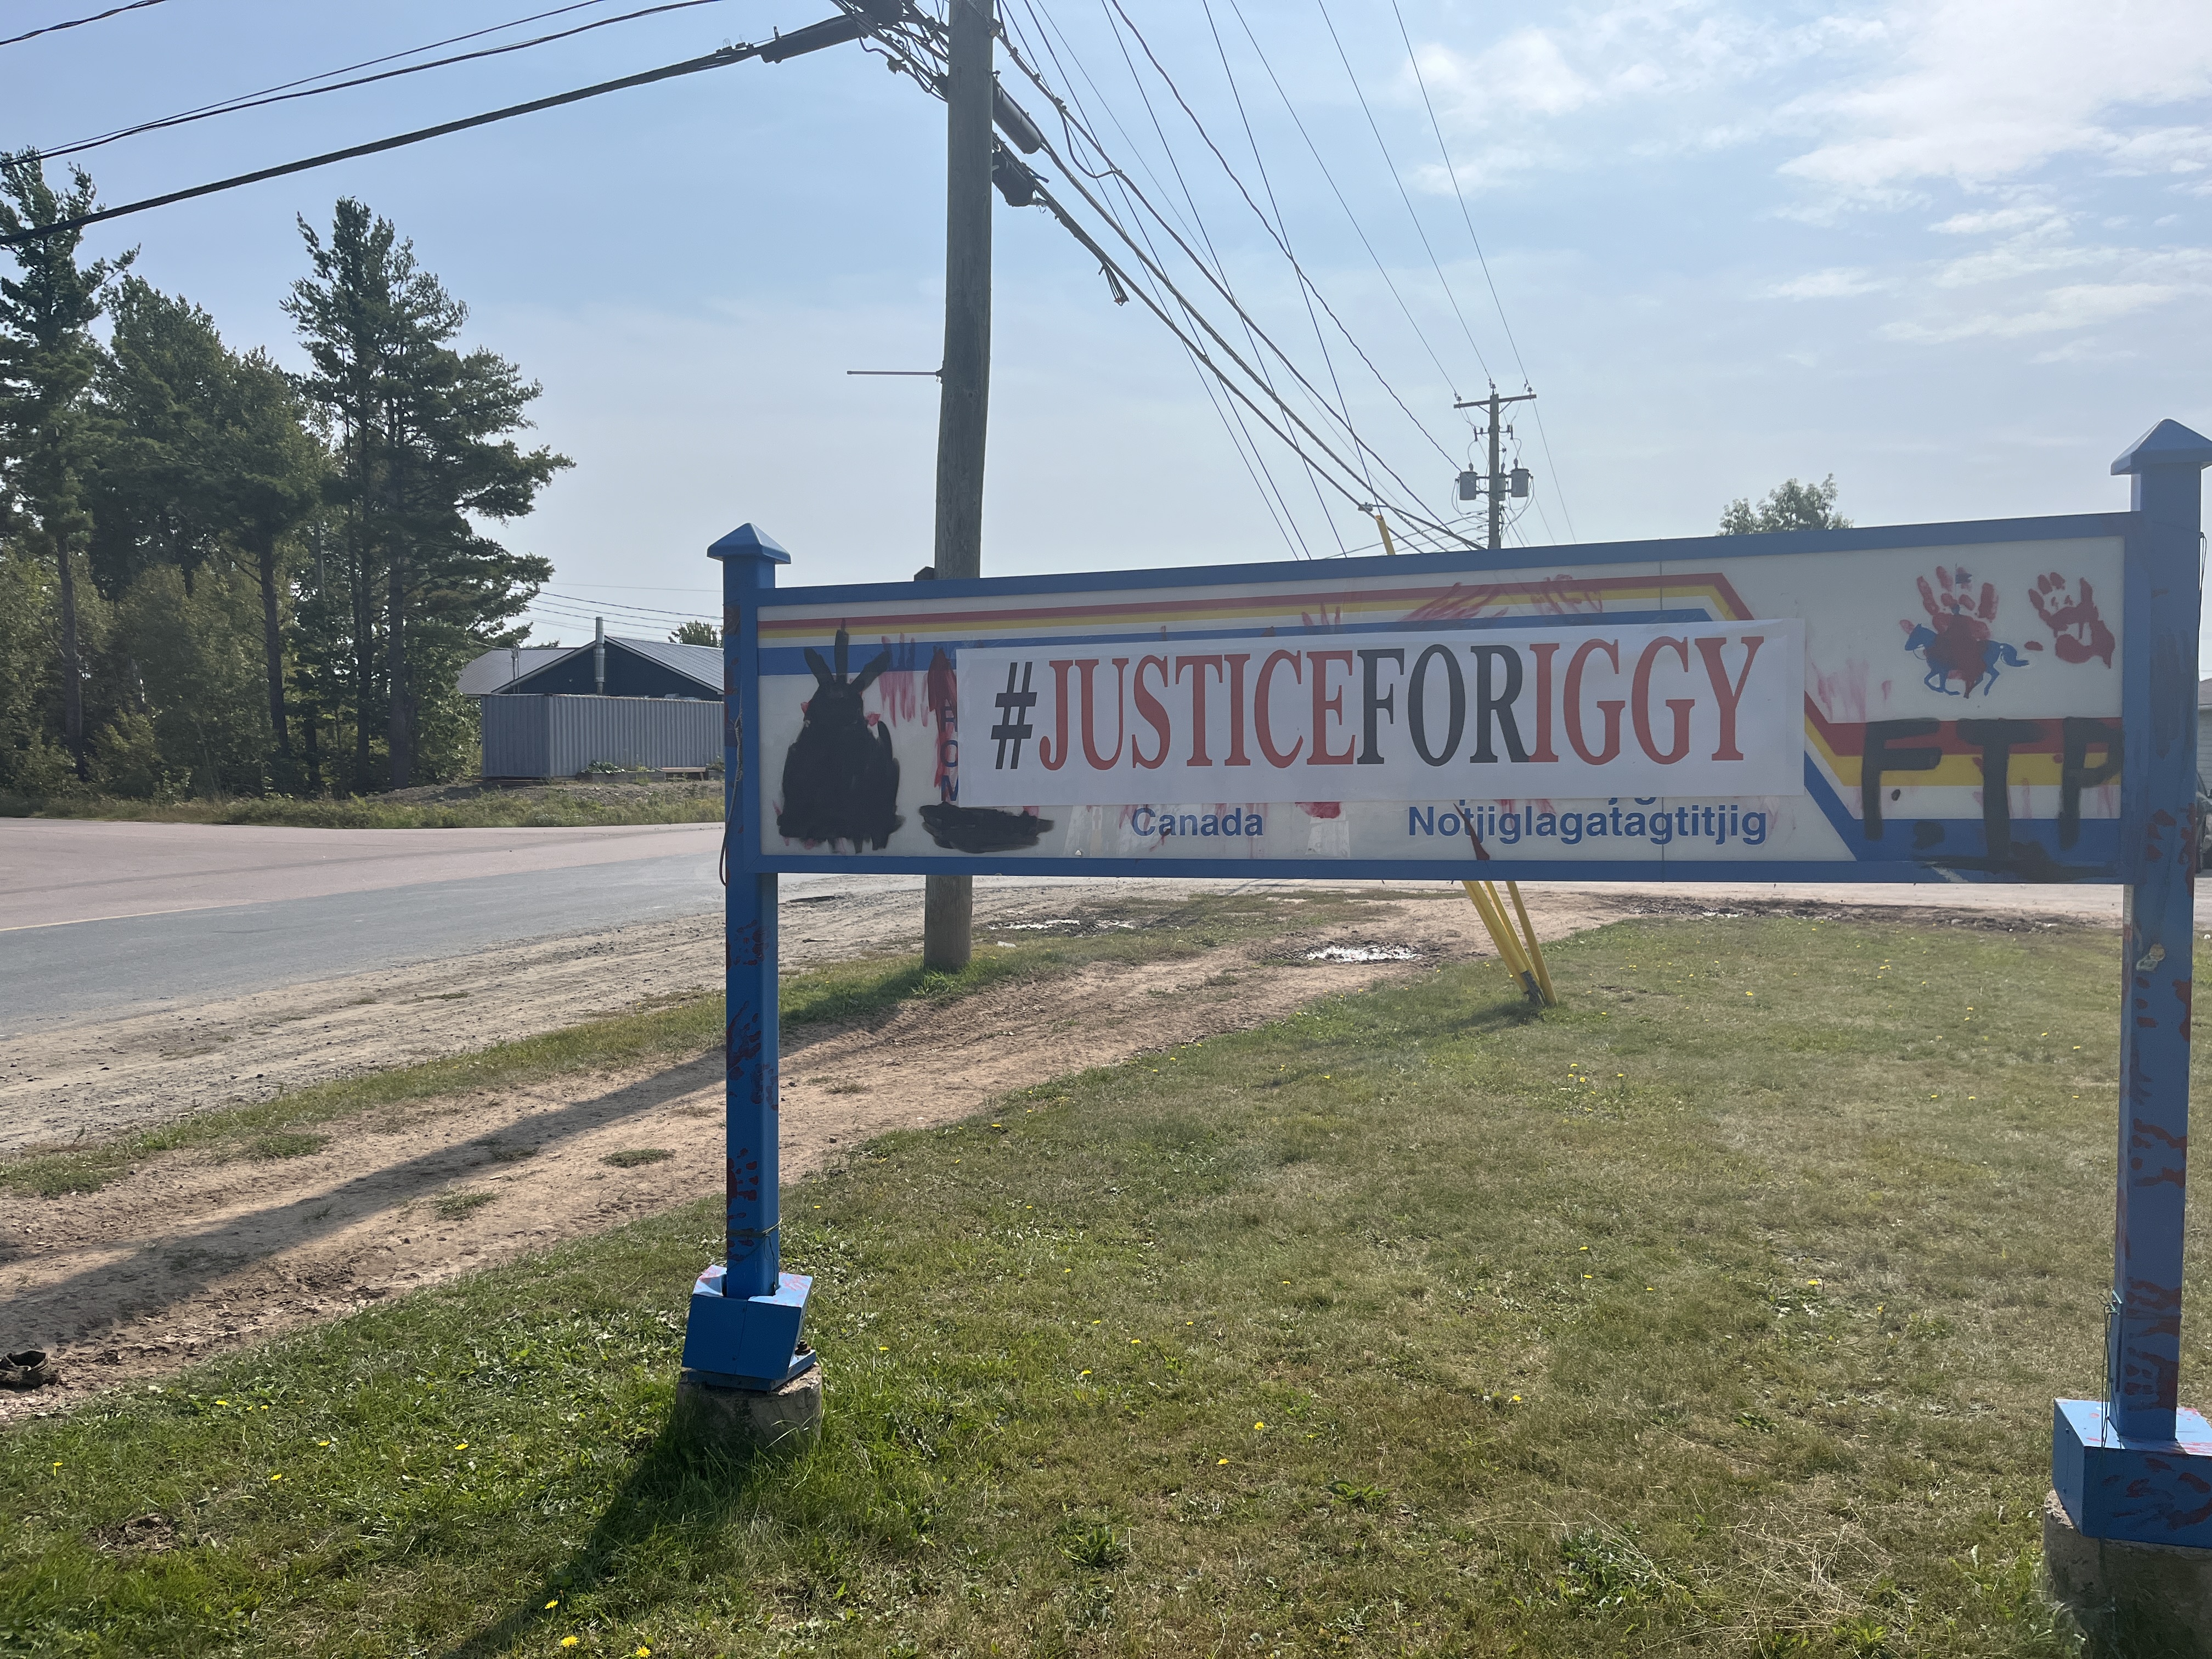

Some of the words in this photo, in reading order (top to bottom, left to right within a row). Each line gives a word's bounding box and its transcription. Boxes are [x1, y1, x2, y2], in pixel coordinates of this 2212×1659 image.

[990, 636, 1765, 771] #JUSTICEFORIGGY
[1132, 807, 1264, 837] Canada
[1408, 805, 1767, 844] Notjiglagatagtitjig
